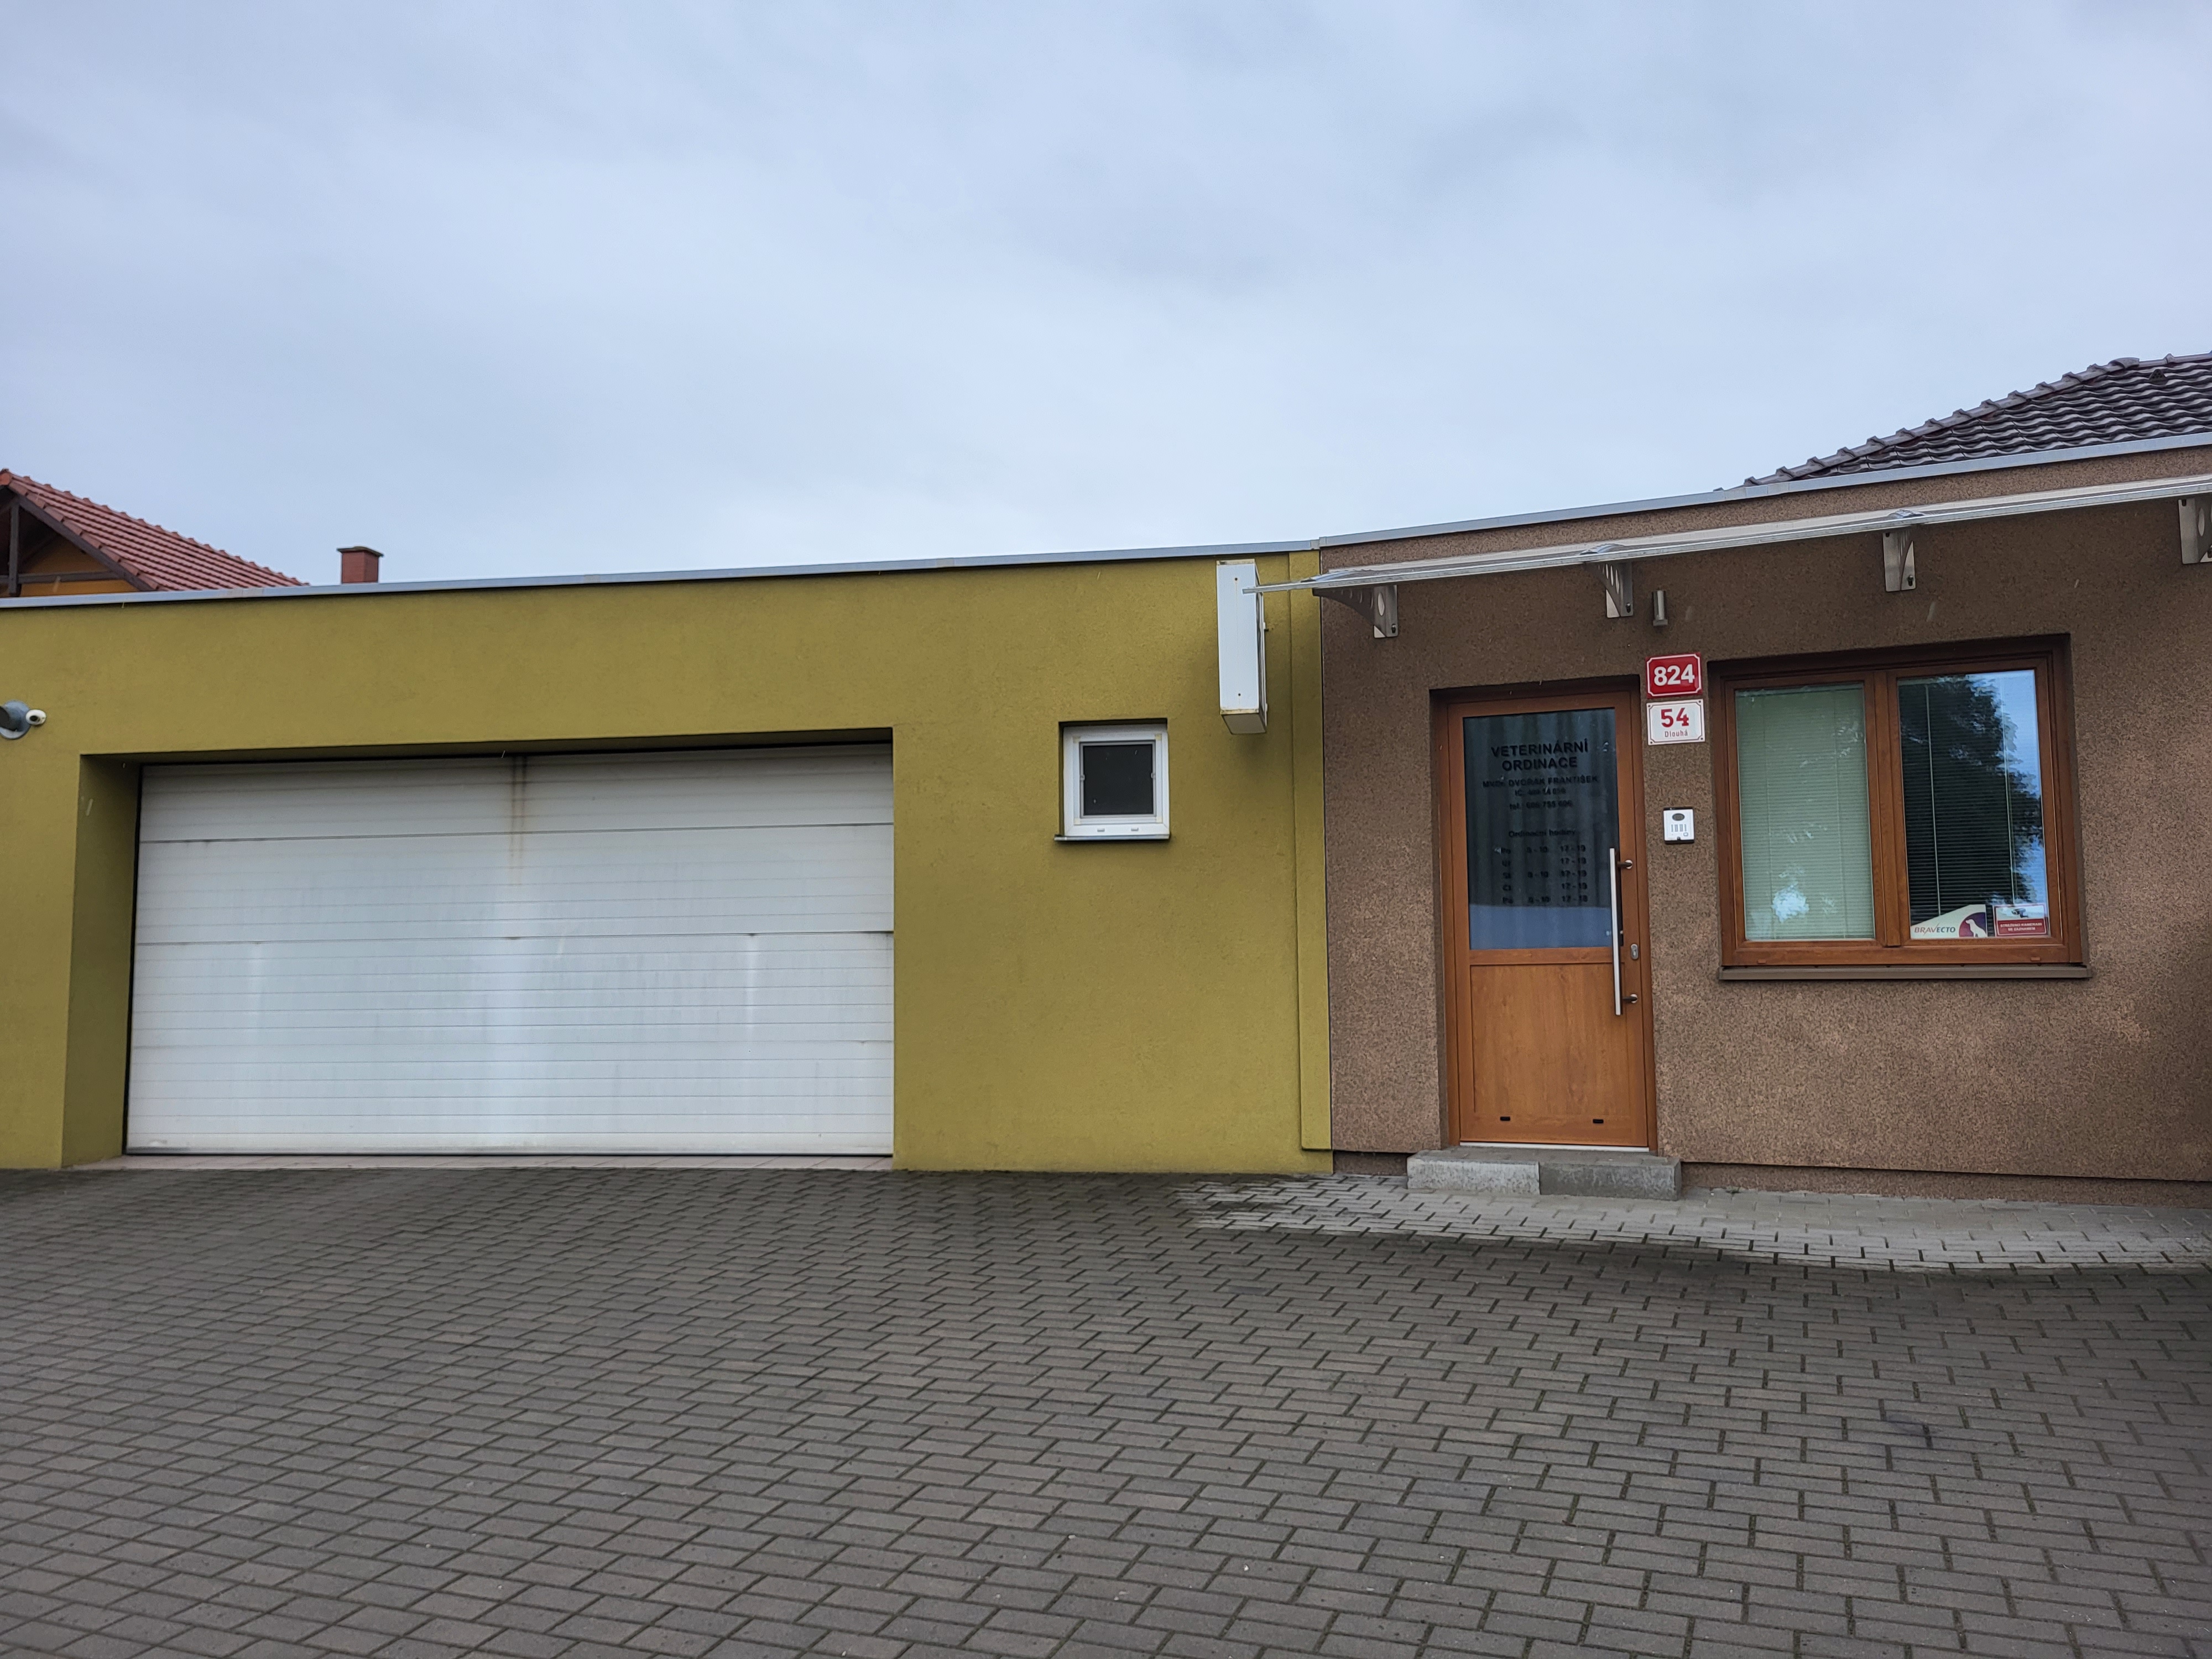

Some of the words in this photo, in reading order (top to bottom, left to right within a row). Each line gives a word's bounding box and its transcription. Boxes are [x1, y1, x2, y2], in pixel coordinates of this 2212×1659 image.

[1653, 664, 1695, 686] 824
[1661, 707, 1689, 728] 54
[1665, 729, 1688, 738] Dlouhá
[1491, 738, 1589, 758] VETERINÁRNÍ
[1502, 756, 1578, 771] ORDINACE
[1914, 924, 1956, 934] BRAVECTO
